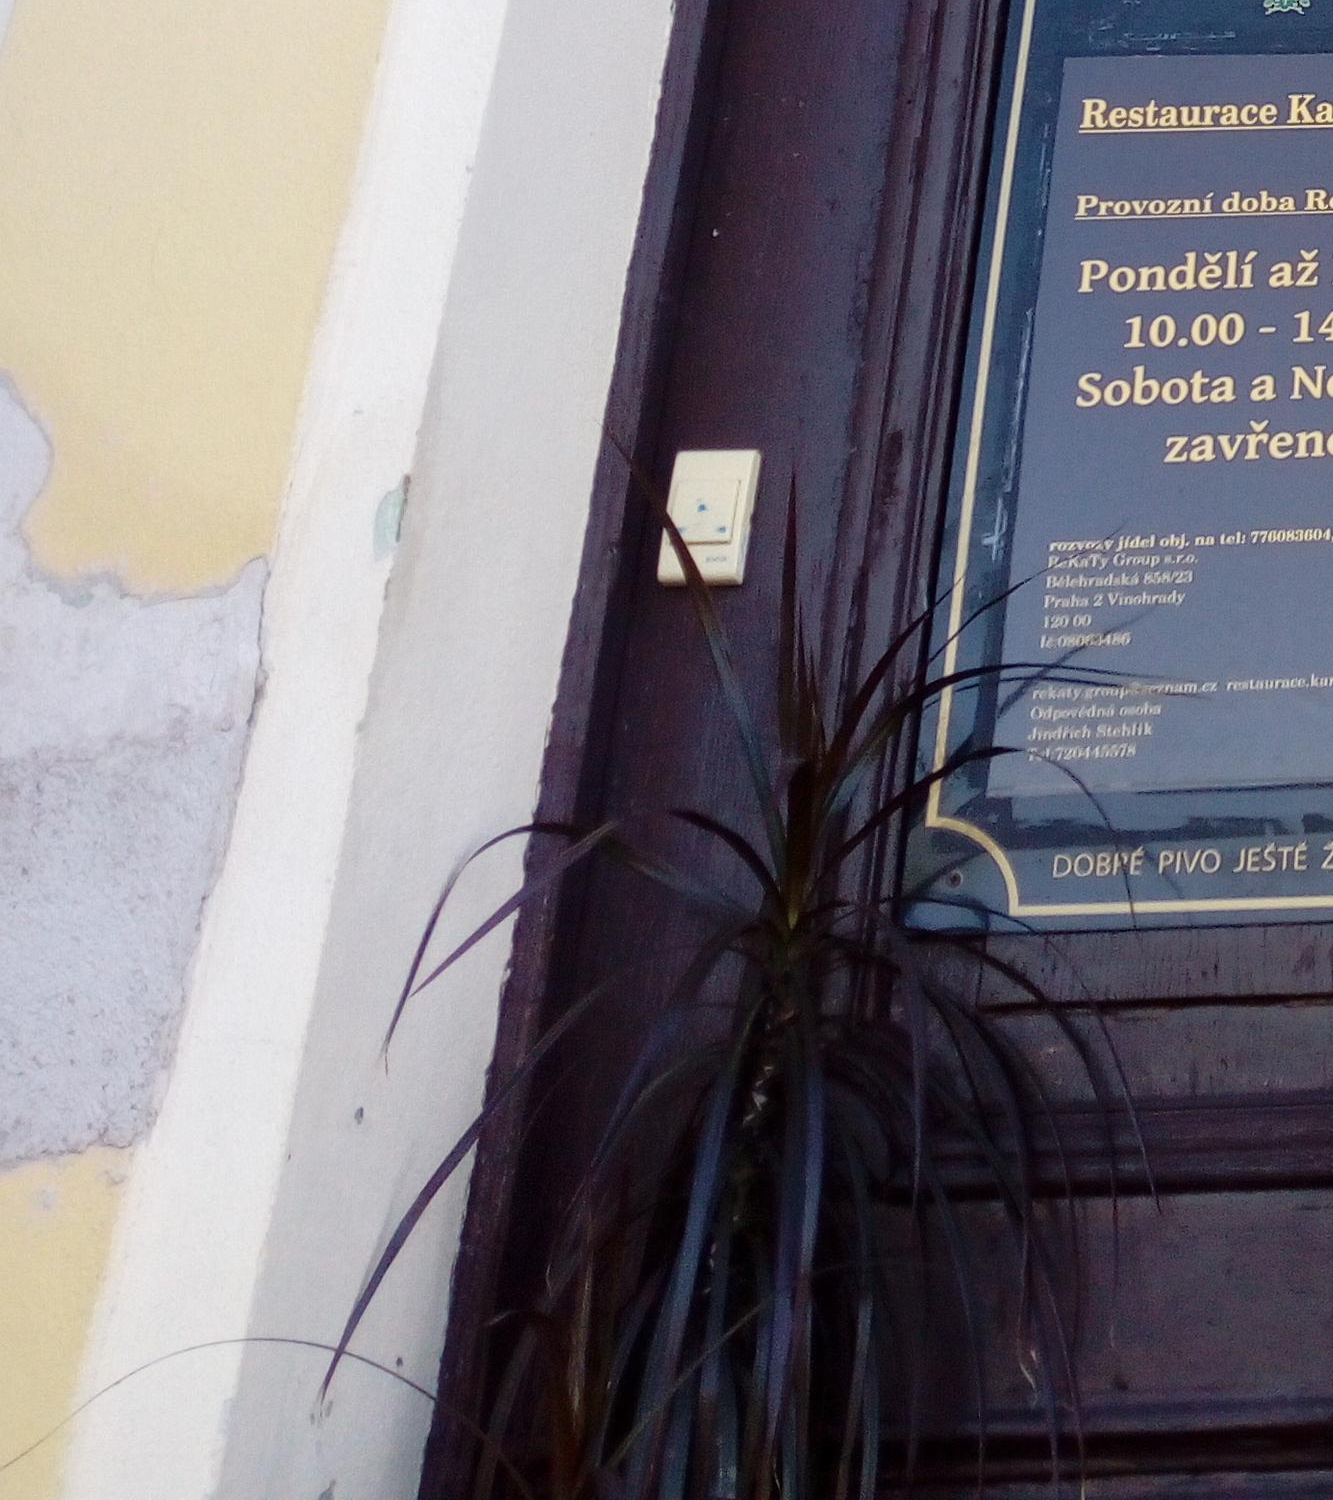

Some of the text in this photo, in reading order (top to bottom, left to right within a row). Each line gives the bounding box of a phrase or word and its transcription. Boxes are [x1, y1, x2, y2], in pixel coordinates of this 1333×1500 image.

[1079, 98, 1278, 128] Restaurace
[1075, 193, 1212, 217] Provozní
[1221, 191, 1296, 213] doba
[1077, 250, 1259, 293] Pondělí
[1268, 249, 1319, 288] až
[1123, 312, 1245, 348] 10.00
[1258, 325, 1277, 334] -
[1076, 365, 1236, 408] Sobota
[1250, 375, 1277, 402] a
[1116, 534, 1156, 552] jídel
[1159, 533, 1190, 549] obj.
[1195, 536, 1214, 547] na
[1112, 553, 1160, 568] Group
[1044, 589, 1186, 609] Praha 2 Vinohrady
[1044, 614, 1092, 629] 120 00
[1158, 849, 1222, 875] PIVO
